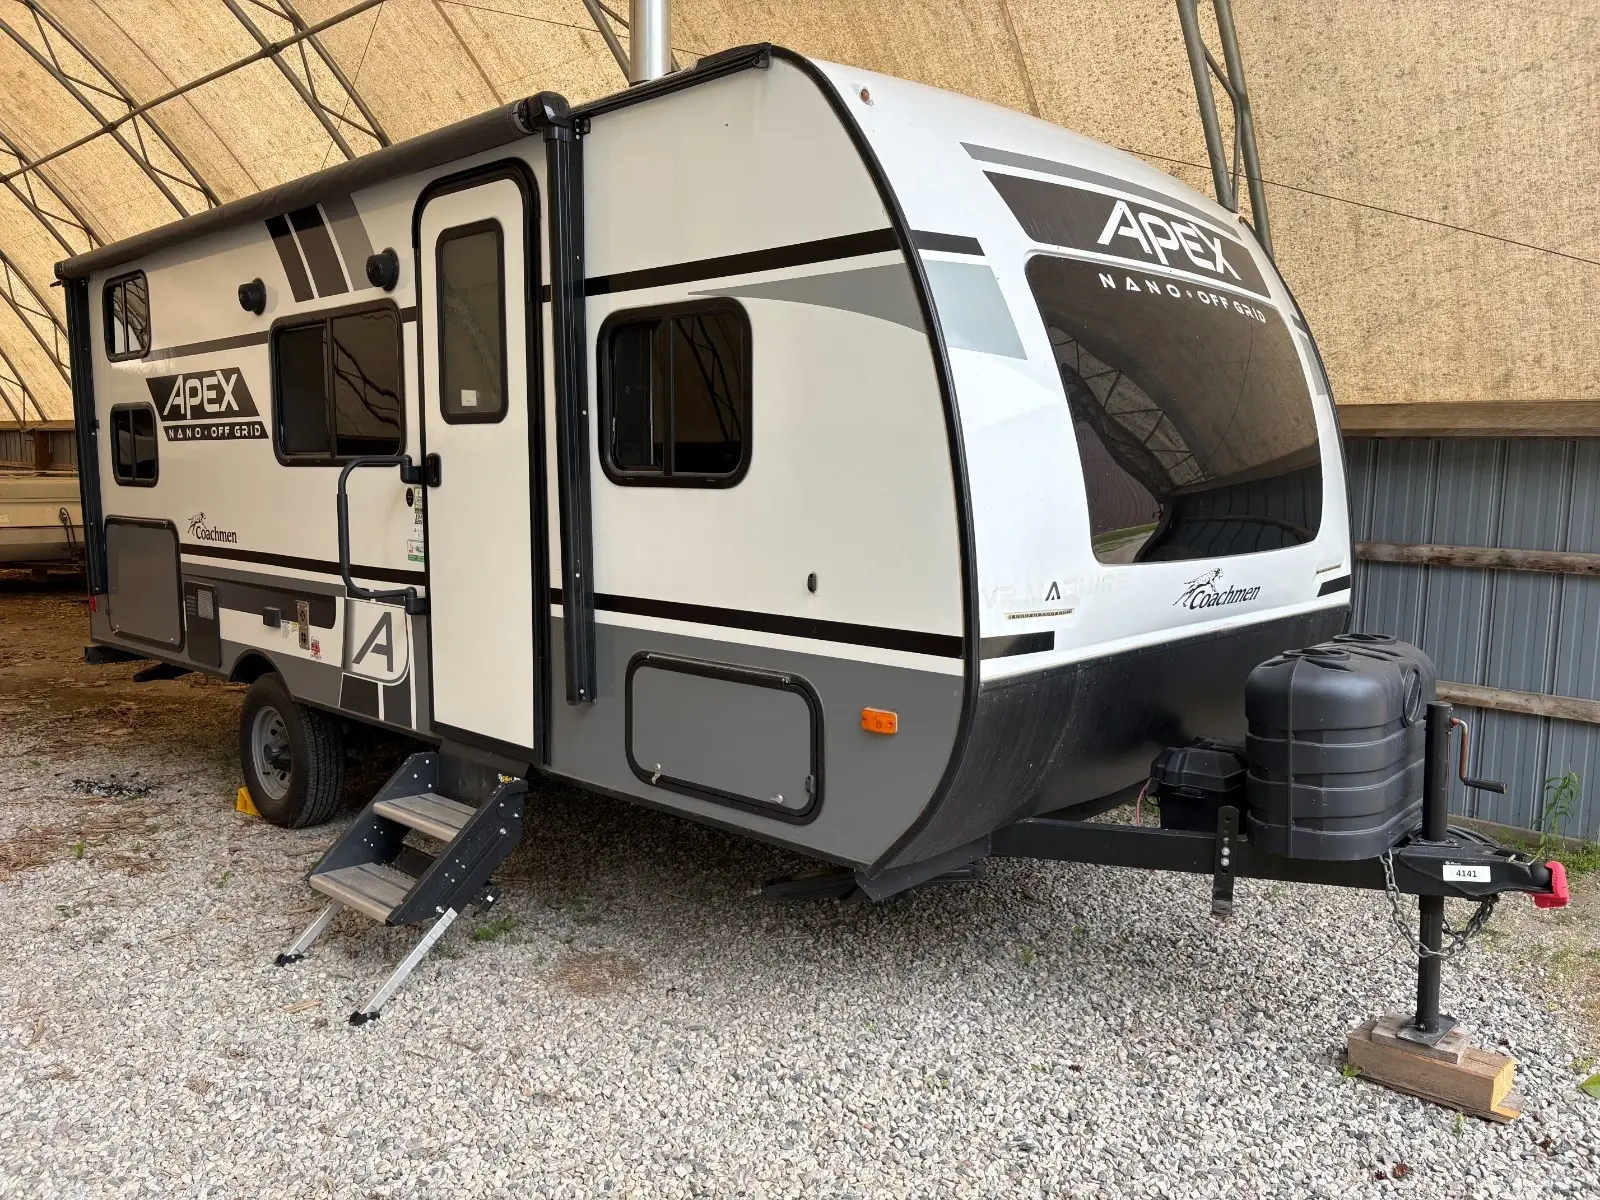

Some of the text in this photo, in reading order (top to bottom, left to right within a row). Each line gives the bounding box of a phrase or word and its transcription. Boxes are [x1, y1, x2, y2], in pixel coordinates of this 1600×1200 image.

[1097, 200, 1242, 281] APEX
[1098, 272, 1267, 323] NANO OFF GRID
[163, 370, 239, 419] APEX
[168, 424, 261, 438] NANO OFF GRID
[195, 525, 238, 544] Coachmen
[1189, 584, 1261, 610] Coachmen
[352, 611, 394, 673] A
[1456, 869, 1478, 878] 4141
